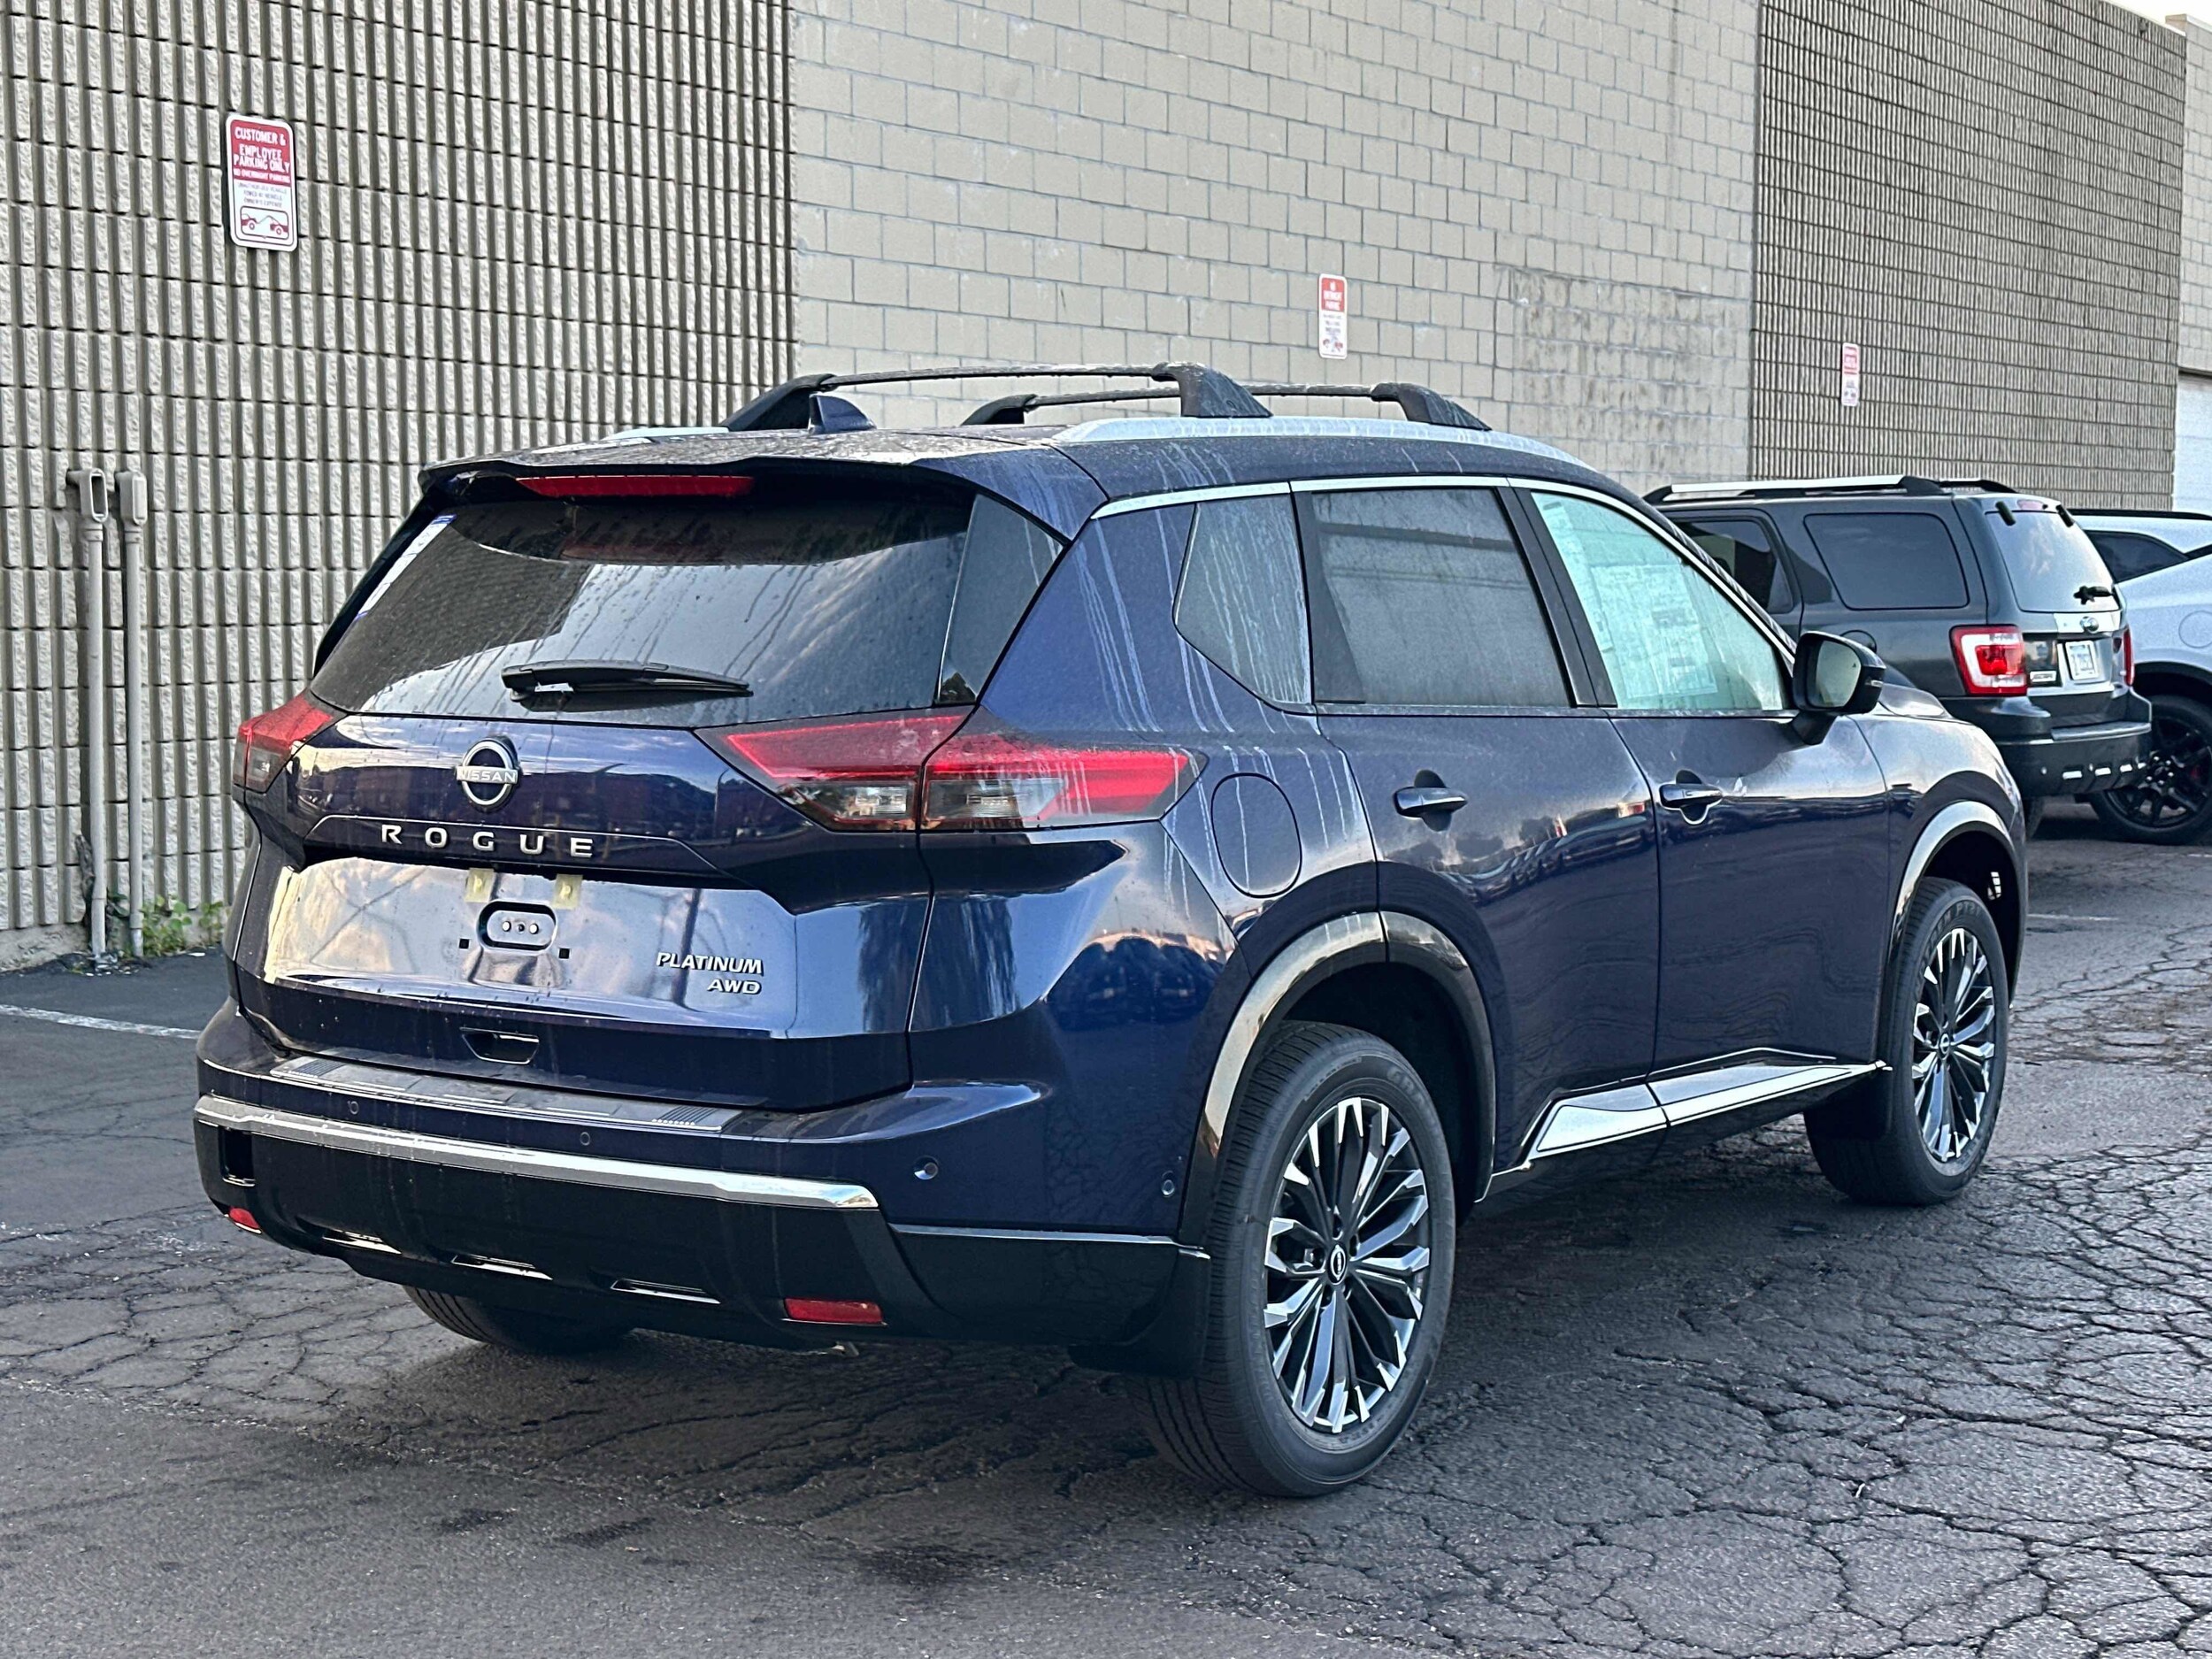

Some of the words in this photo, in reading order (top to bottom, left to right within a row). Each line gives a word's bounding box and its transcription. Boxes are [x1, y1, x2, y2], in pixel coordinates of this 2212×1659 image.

[234, 127, 278, 145] CUSTOMER
[280, 134, 287, 146] &
[239, 143, 282, 161] EMPLOYEE
[234, 154, 268, 170] PARKING
[269, 160, 290, 173] ONLY
[457, 766, 517, 782] NISSAN
[381, 824, 594, 858] ROGUE
[656, 952, 763, 975] PLATINUM
[707, 979, 762, 995] AWD
